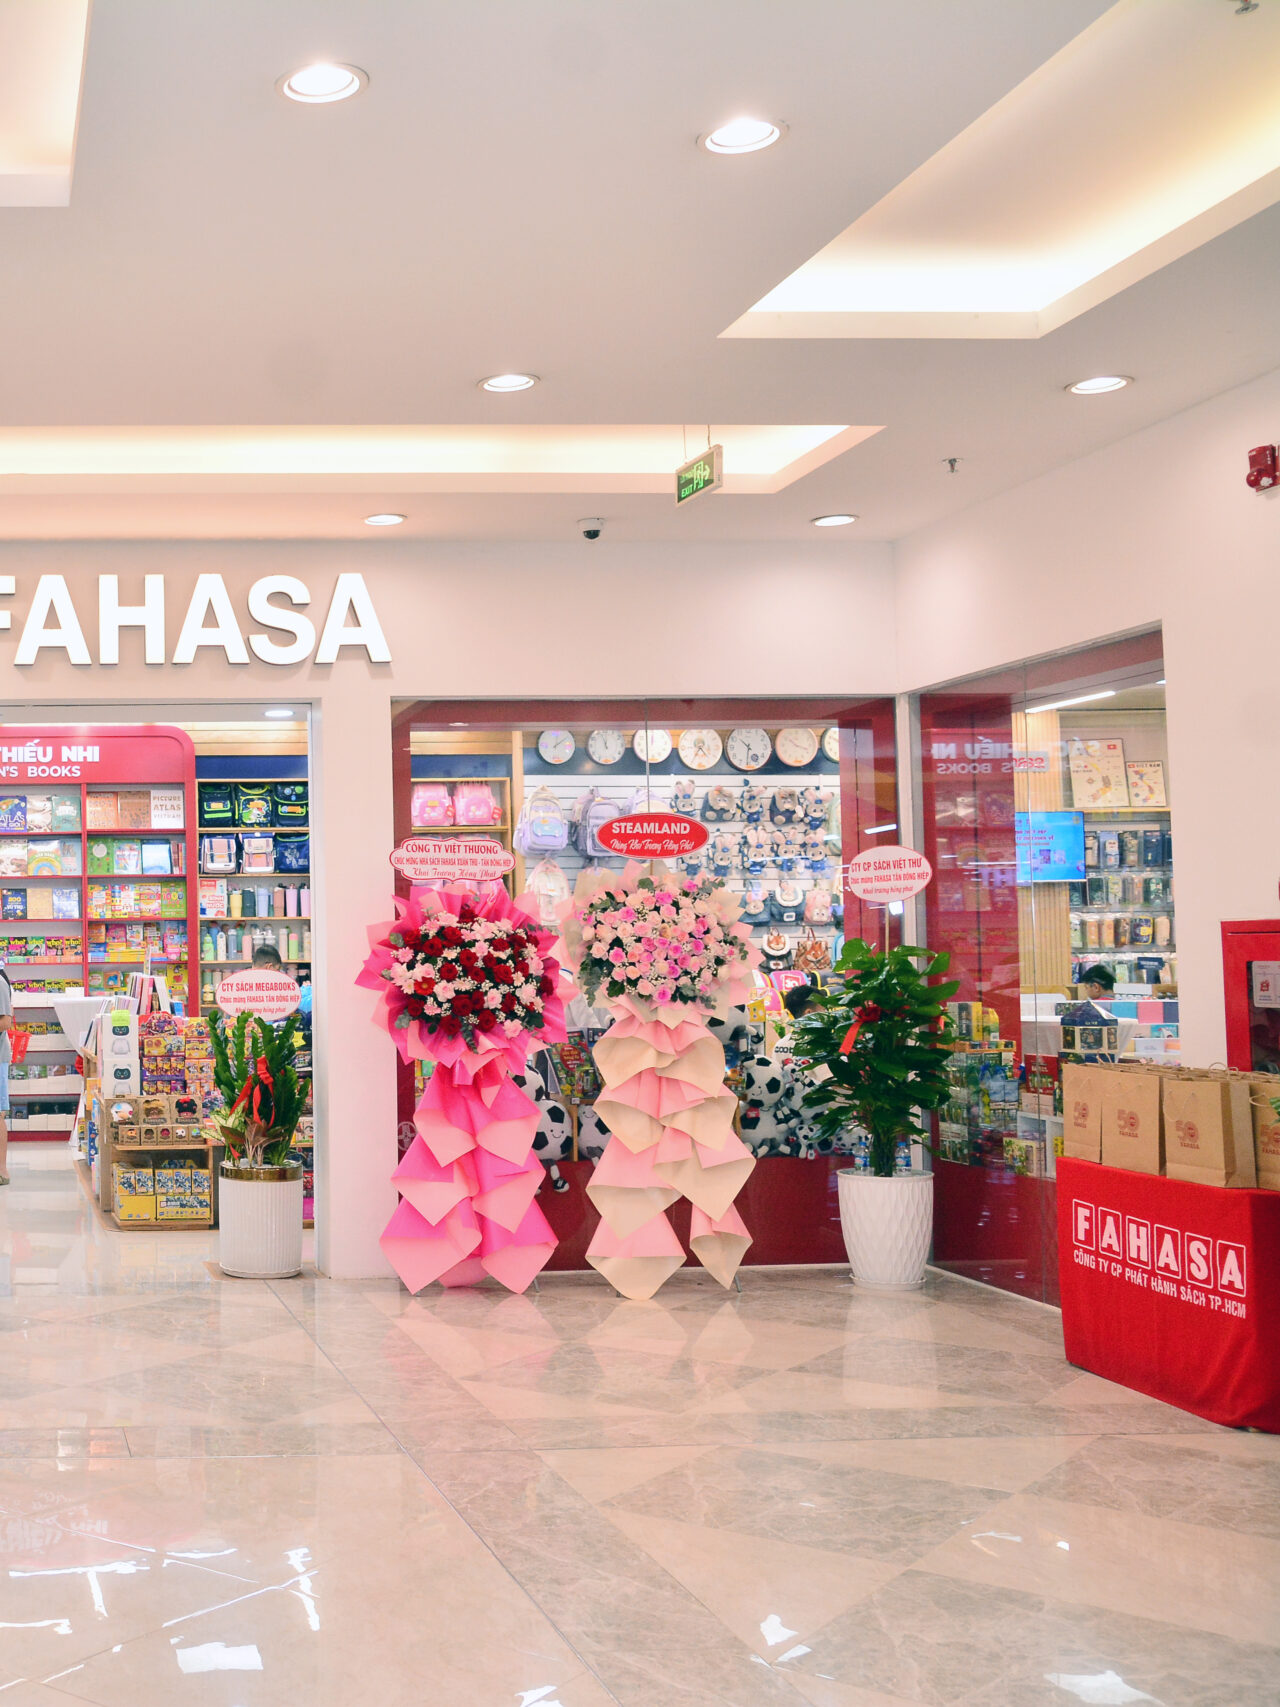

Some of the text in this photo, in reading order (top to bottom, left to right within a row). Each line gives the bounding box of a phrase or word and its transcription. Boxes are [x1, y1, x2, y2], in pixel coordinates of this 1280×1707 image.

[61, 746, 100, 763] NHI
[27, 765, 81, 777] BOOKS
[153, 804, 182, 812] ATLAS
[0, 814, 25, 823] ATLAS
[612, 822, 691, 834] STEAMLAND
[406, 843, 431, 853] CÔNG
[433, 844, 442, 853] TY
[445, 842, 461, 854] VIỆT
[851, 863, 861, 872] CTY
[863, 862, 872, 871] CP
[873, 859, 891, 871] SÁCH
[892, 857, 906, 871] VIỆT
[221, 980, 296, 992] CTY SÁCH MEGABOOKS
[1117, 1109, 1140, 1133] 50
[1175, 1120, 1199, 1143] 50
[1180, 1142, 1200, 1150] FAHASA
[1075, 1203, 1245, 1293] FAHASA
[1074, 1248, 1246, 1319] CÔNG TY CP PHÁT HÀNH SÁCH TP.HCM
